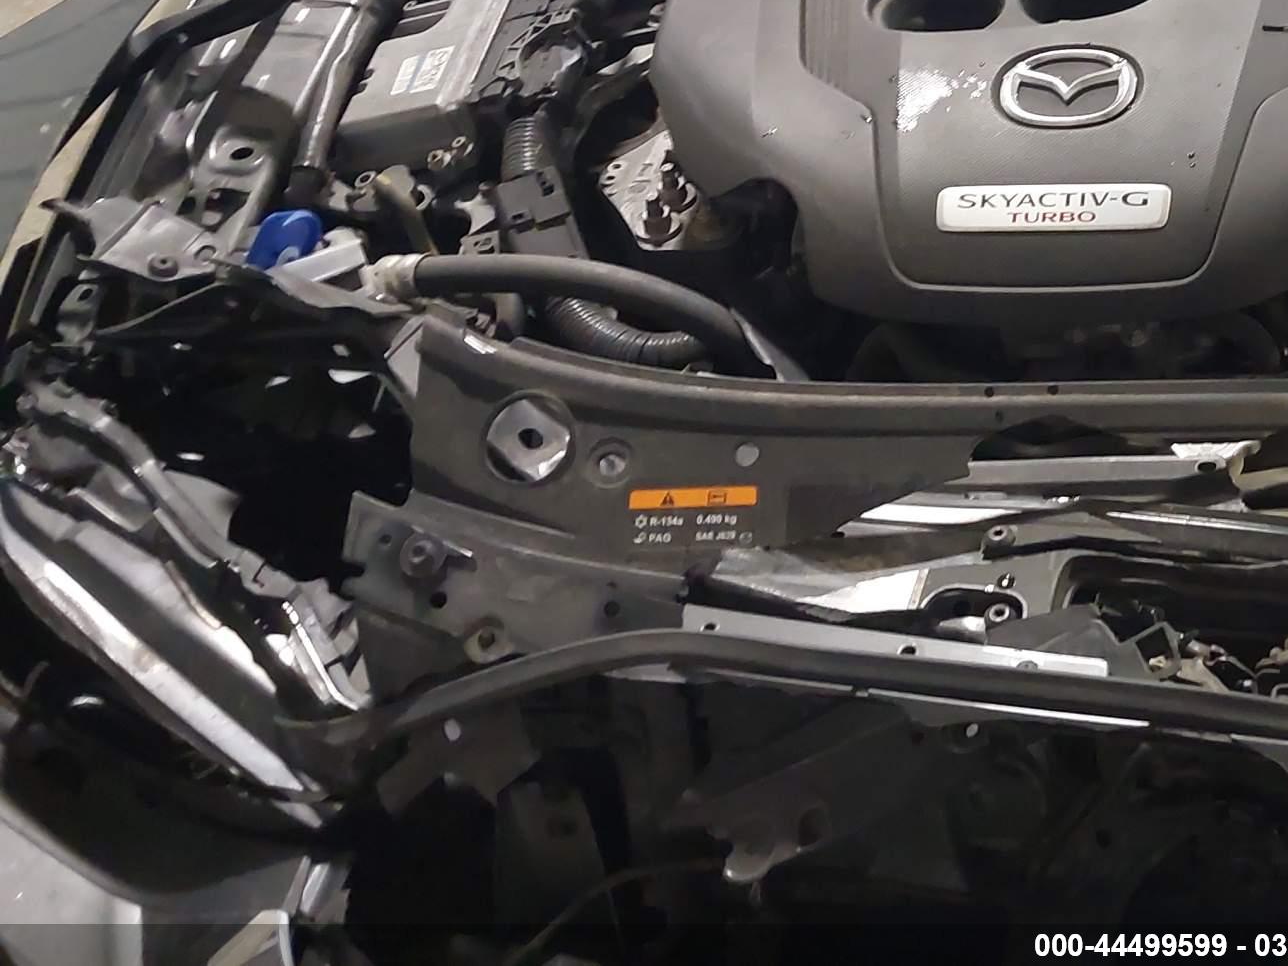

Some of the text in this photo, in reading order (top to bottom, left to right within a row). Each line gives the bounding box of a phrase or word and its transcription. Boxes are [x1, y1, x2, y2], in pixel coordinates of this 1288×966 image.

[957, 191, 1149, 209] SKYACTIV-G
[1007, 211, 1097, 223] TURBO
[724, 514, 737, 526] kg
